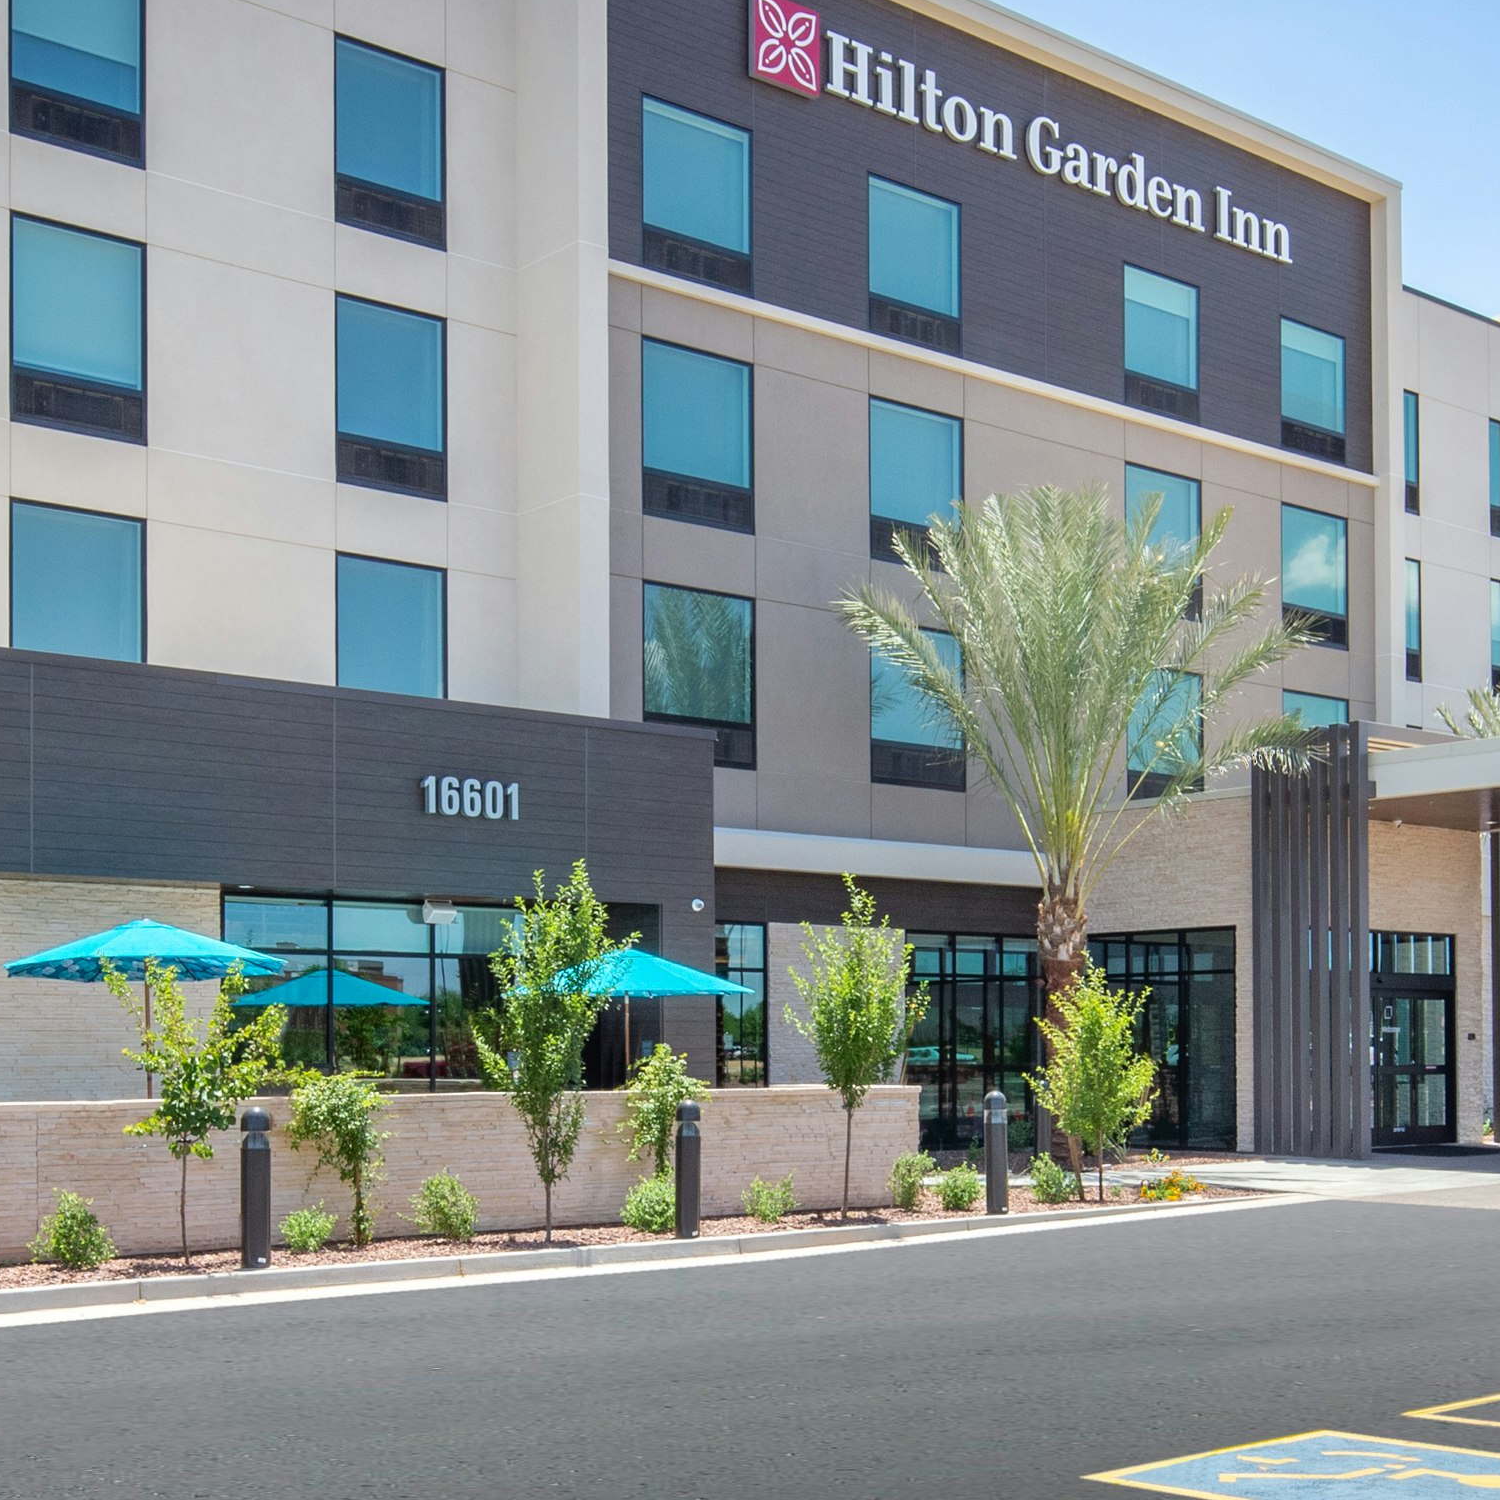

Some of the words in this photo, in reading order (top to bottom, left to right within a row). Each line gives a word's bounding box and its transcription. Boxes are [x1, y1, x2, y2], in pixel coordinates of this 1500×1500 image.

[824, 30, 1017, 160] Hilton
[1025, 116, 1205, 232] Garden
[1212, 185, 1293, 264] Inn
[420, 775, 519, 820] 16601
